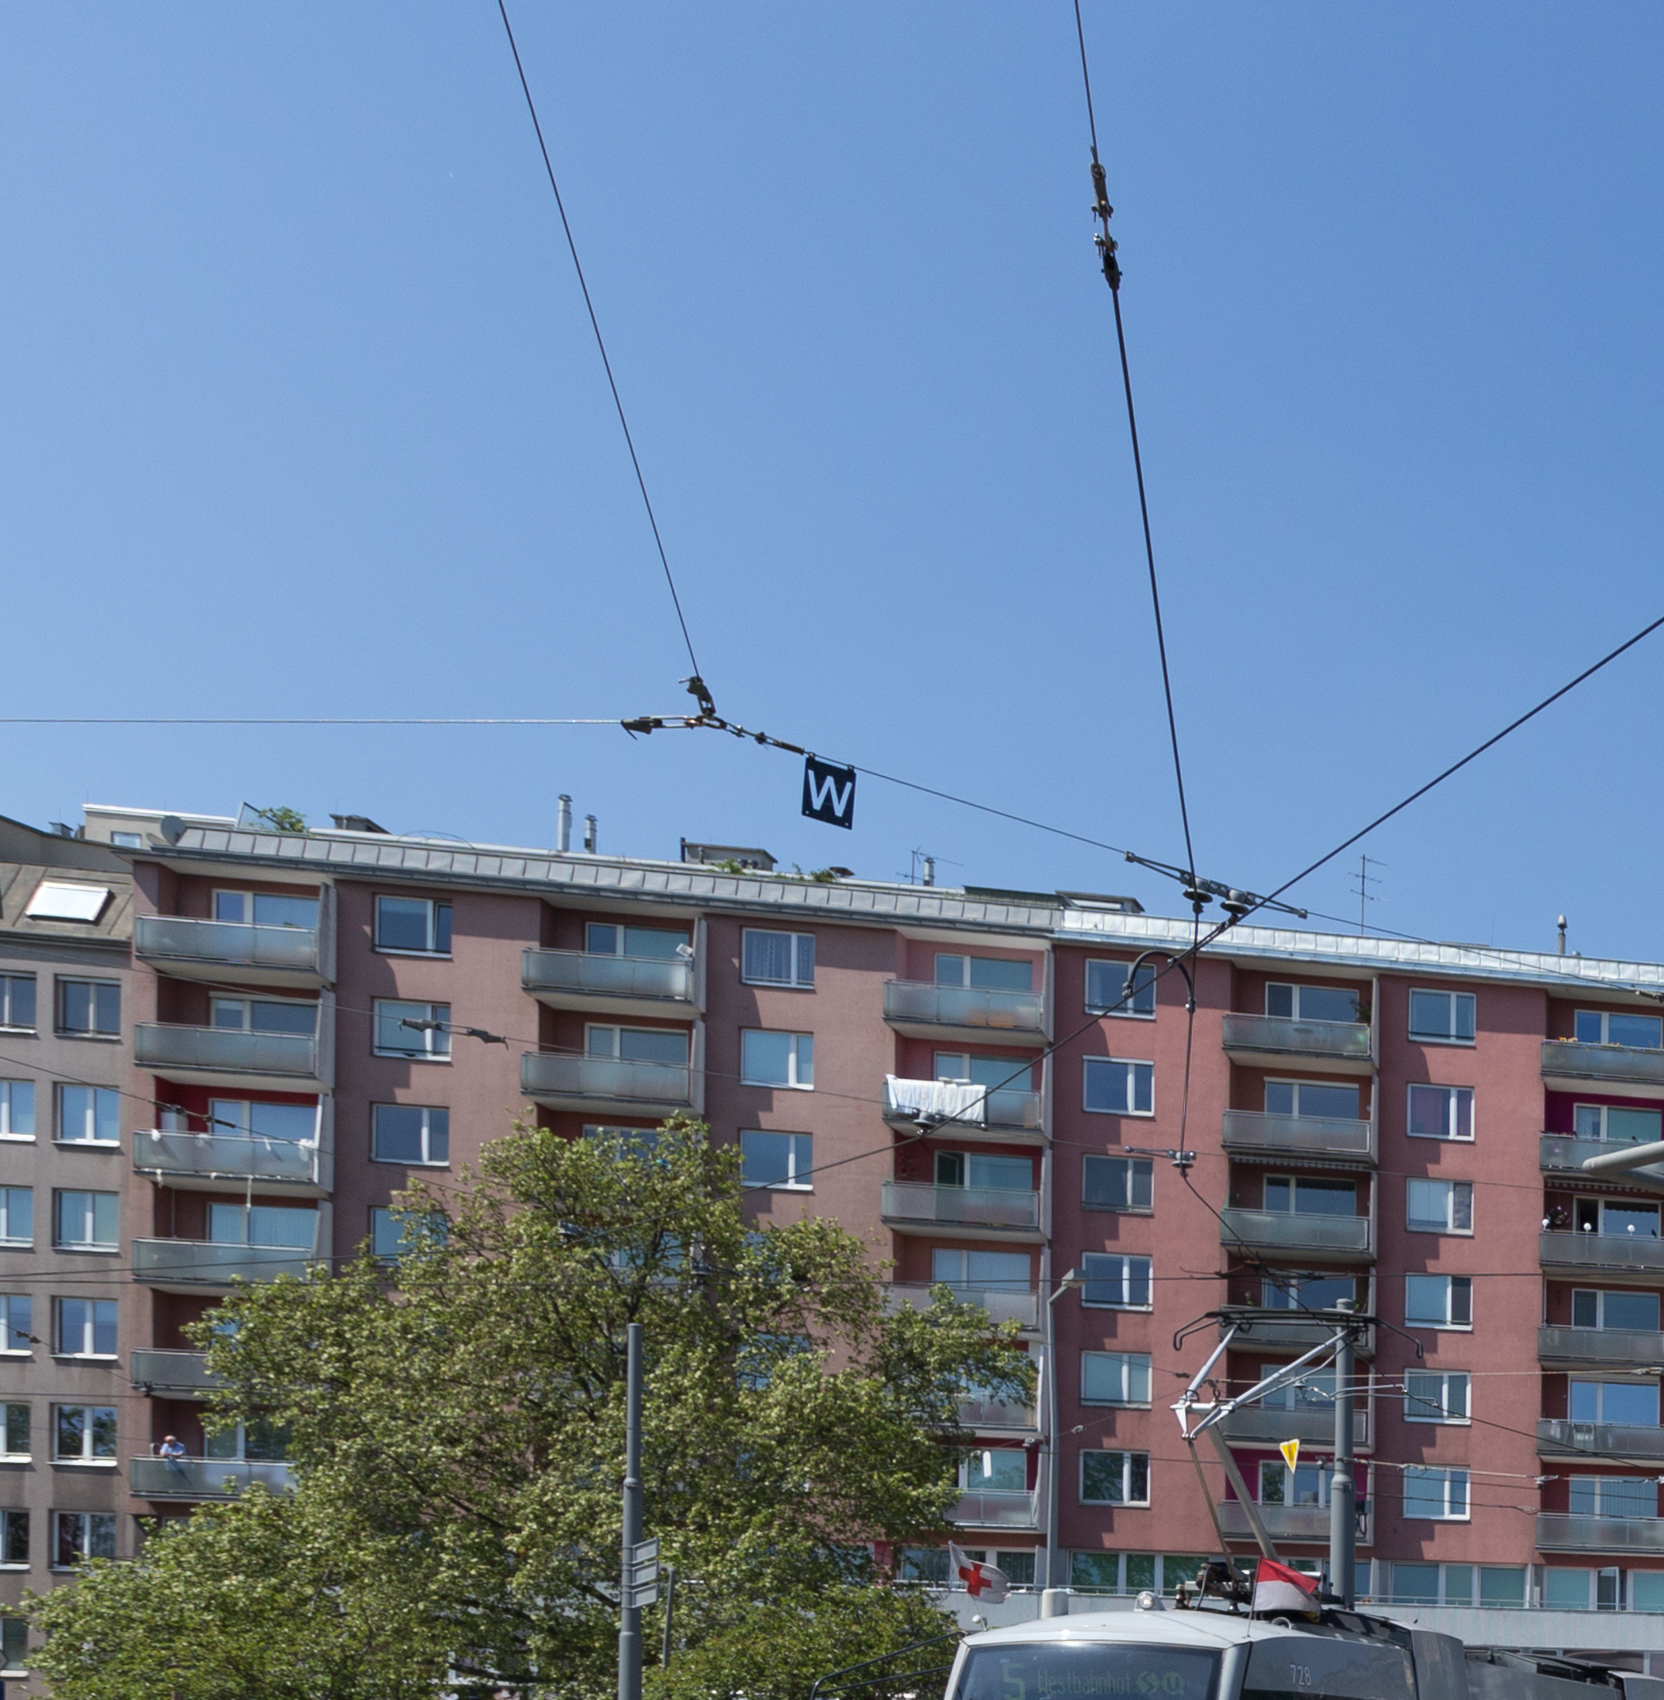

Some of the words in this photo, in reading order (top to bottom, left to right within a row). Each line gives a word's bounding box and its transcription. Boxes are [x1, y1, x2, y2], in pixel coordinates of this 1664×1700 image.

[808, 768, 853, 818] W
[1038, 1670, 1131, 1695] Westbahnhof
[1289, 1664, 1312, 1686] 728
